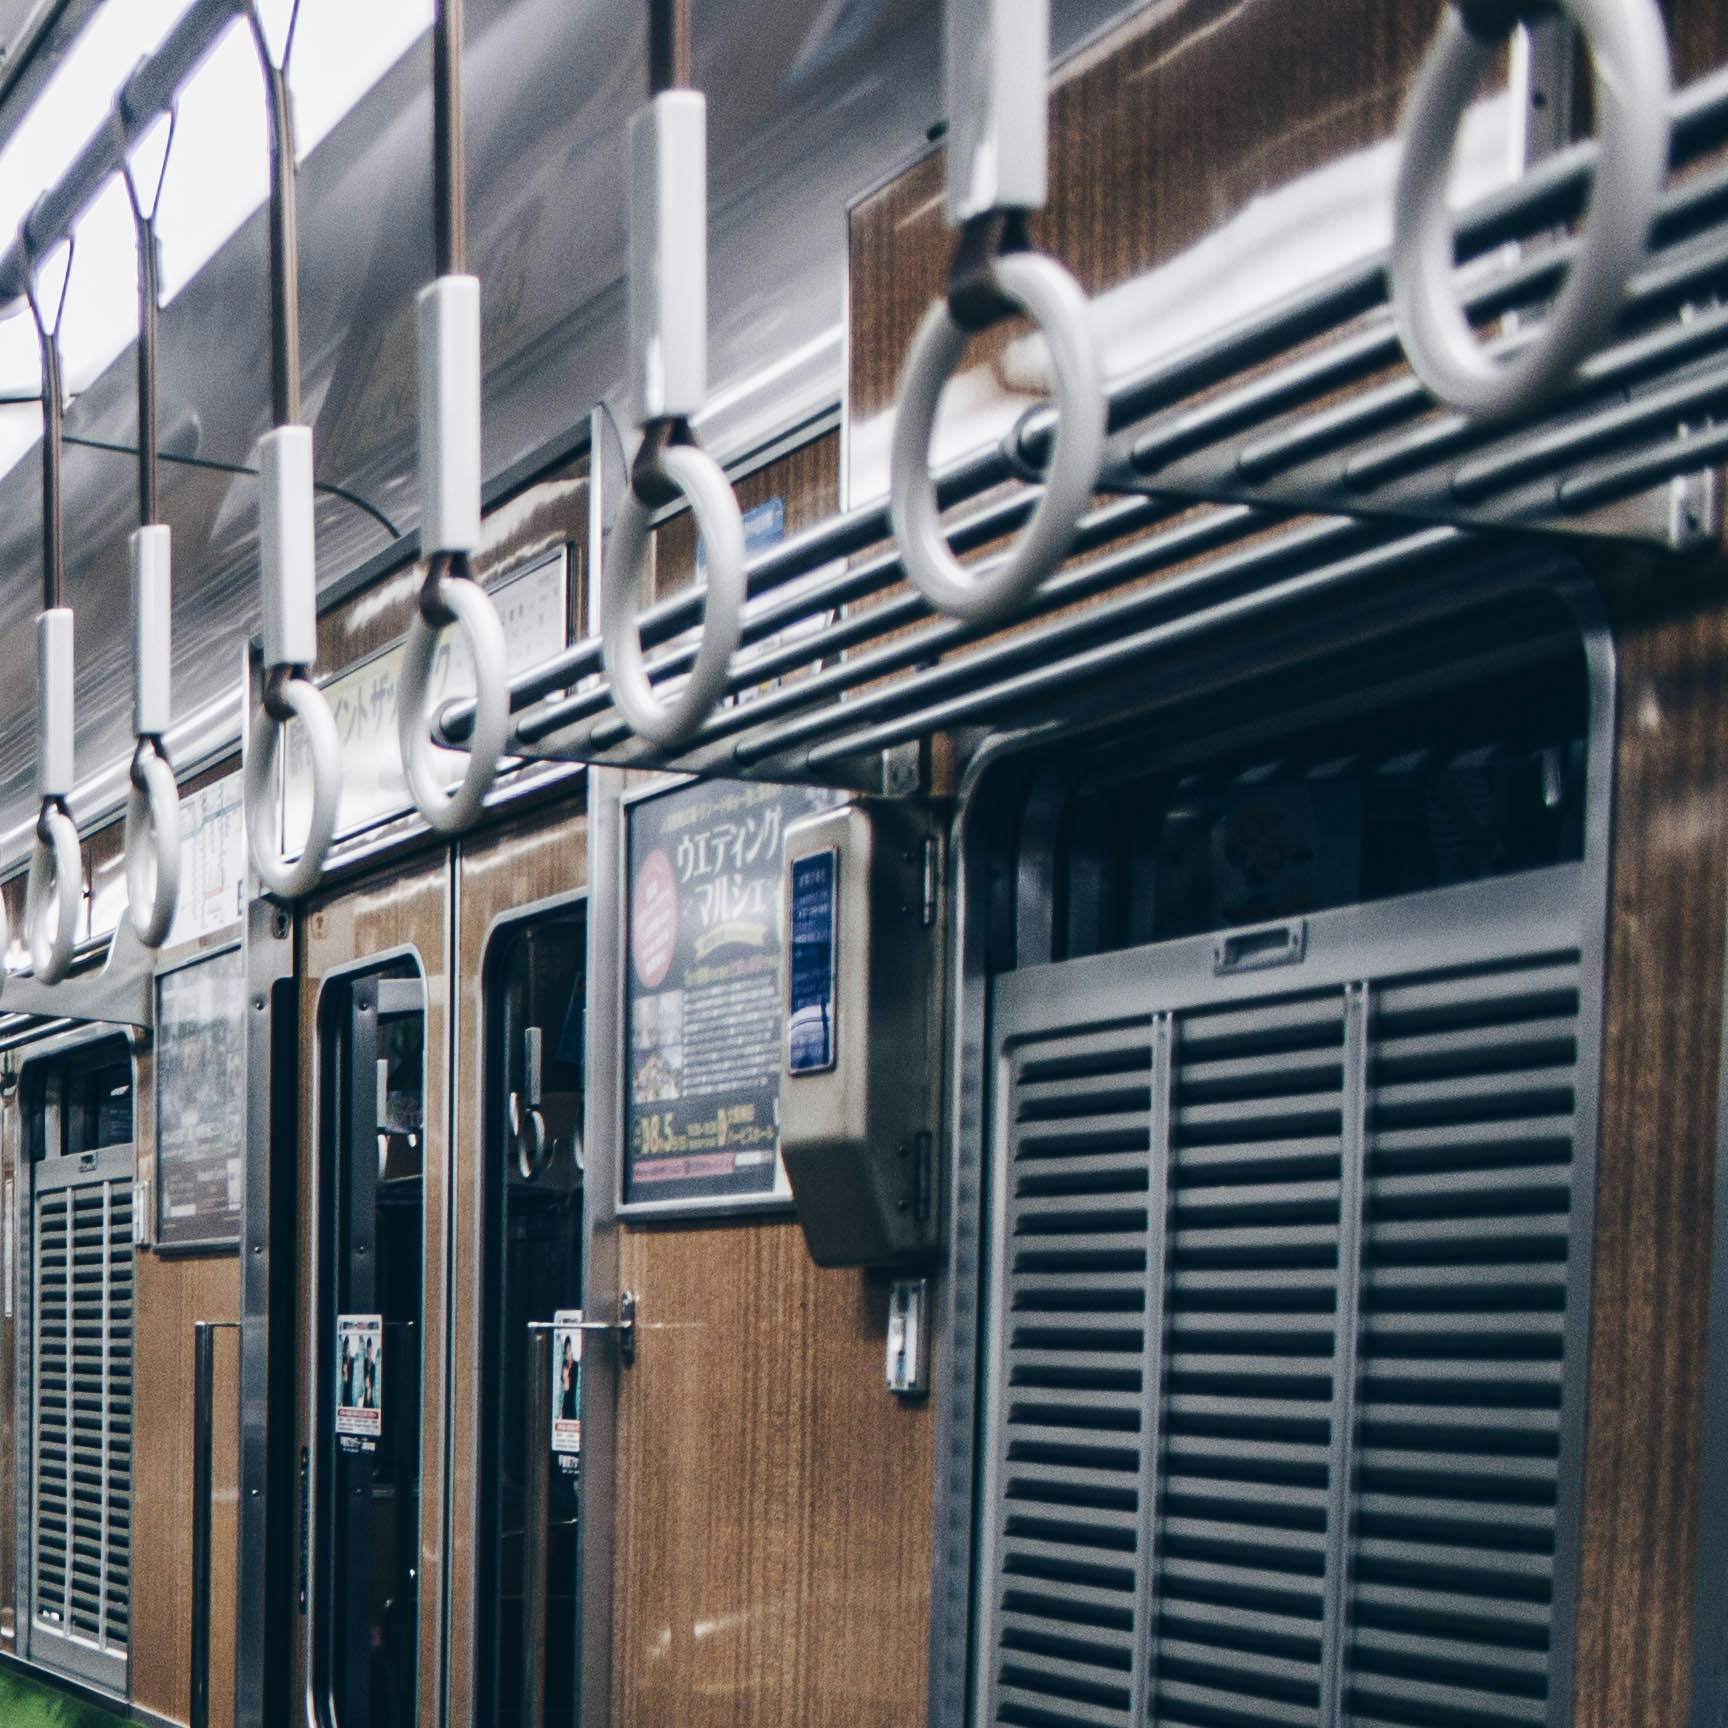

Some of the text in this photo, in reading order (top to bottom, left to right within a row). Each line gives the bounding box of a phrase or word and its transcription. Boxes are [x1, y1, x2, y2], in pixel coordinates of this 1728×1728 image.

[677, 806, 782, 883] ウエディング
[696, 873, 768, 927] マルシェ
